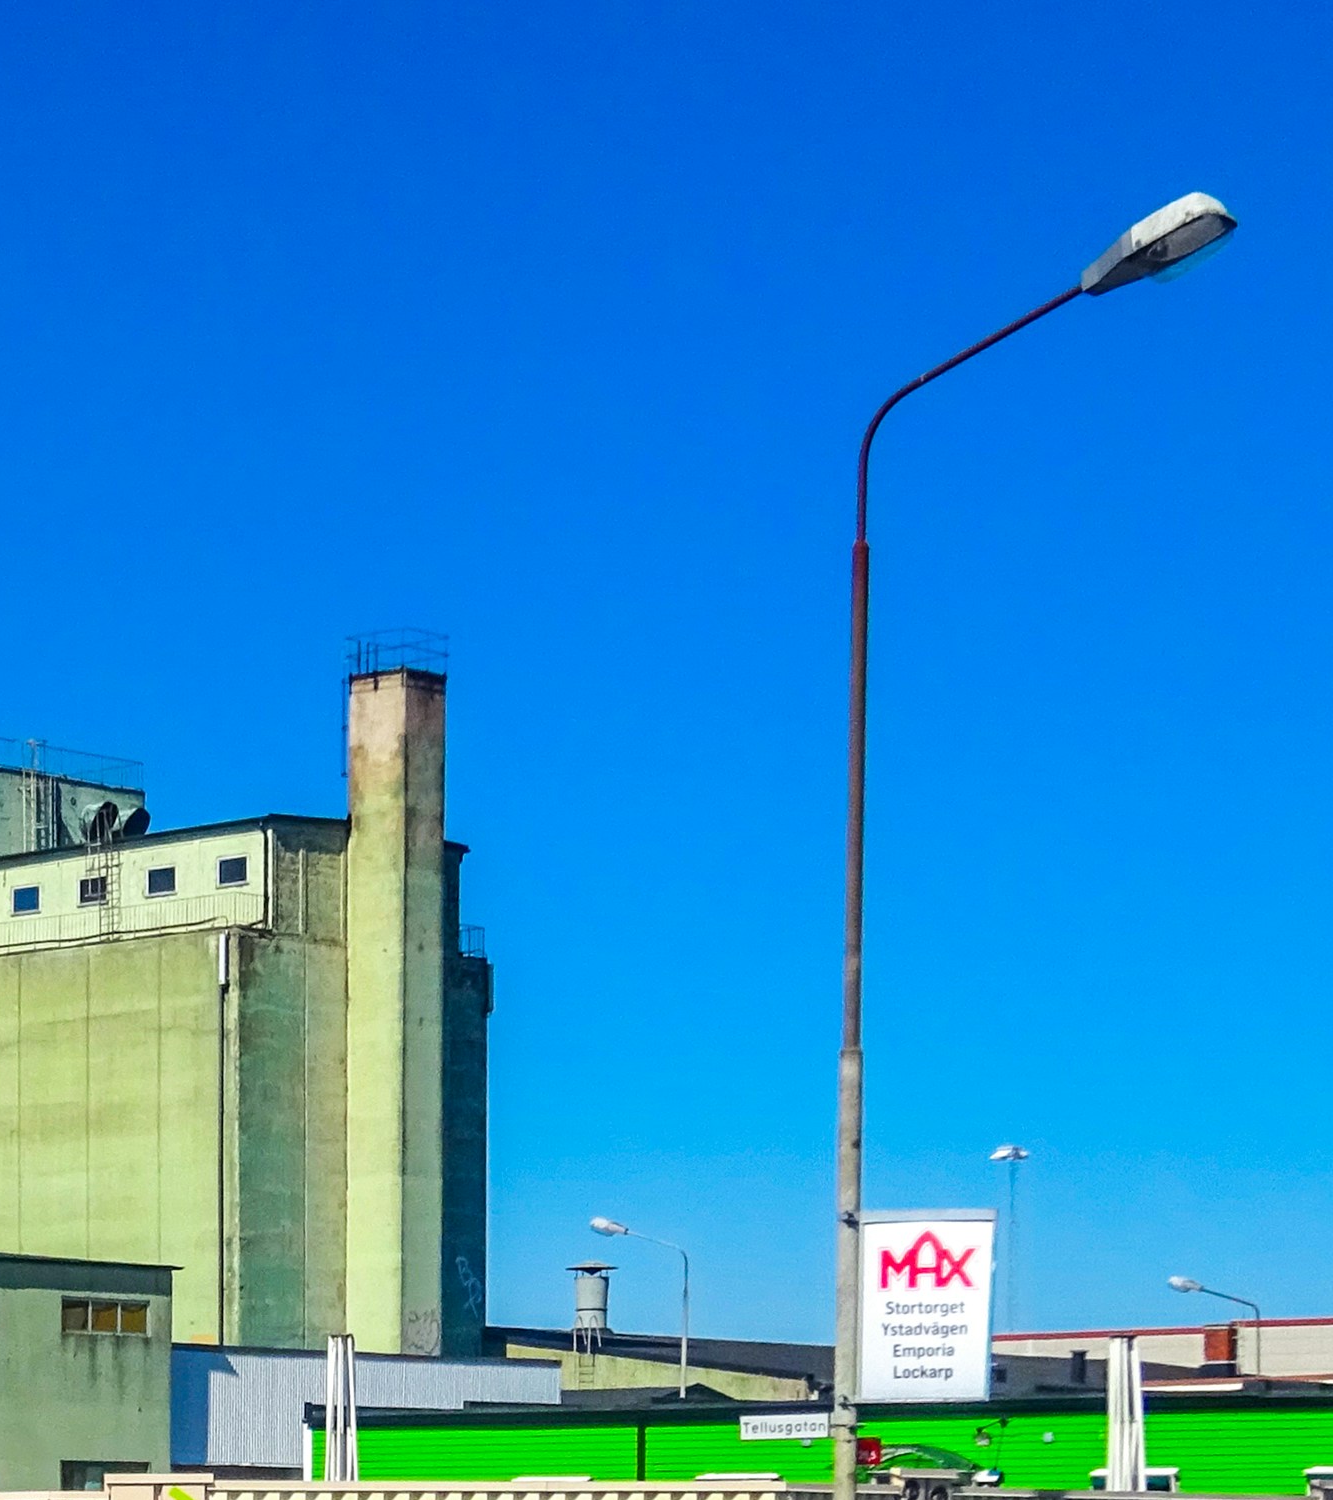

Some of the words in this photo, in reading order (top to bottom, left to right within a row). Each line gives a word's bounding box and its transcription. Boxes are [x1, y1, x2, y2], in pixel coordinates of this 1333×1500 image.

[880, 1230, 976, 1289] MAX
[885, 1300, 965, 1317] Stortorget
[882, 1321, 969, 1338] Ystadvägen
[892, 1343, 955, 1359] Emporia
[893, 1365, 954, 1382] Lockarp
[743, 1419, 826, 1435] Tellusgatan
